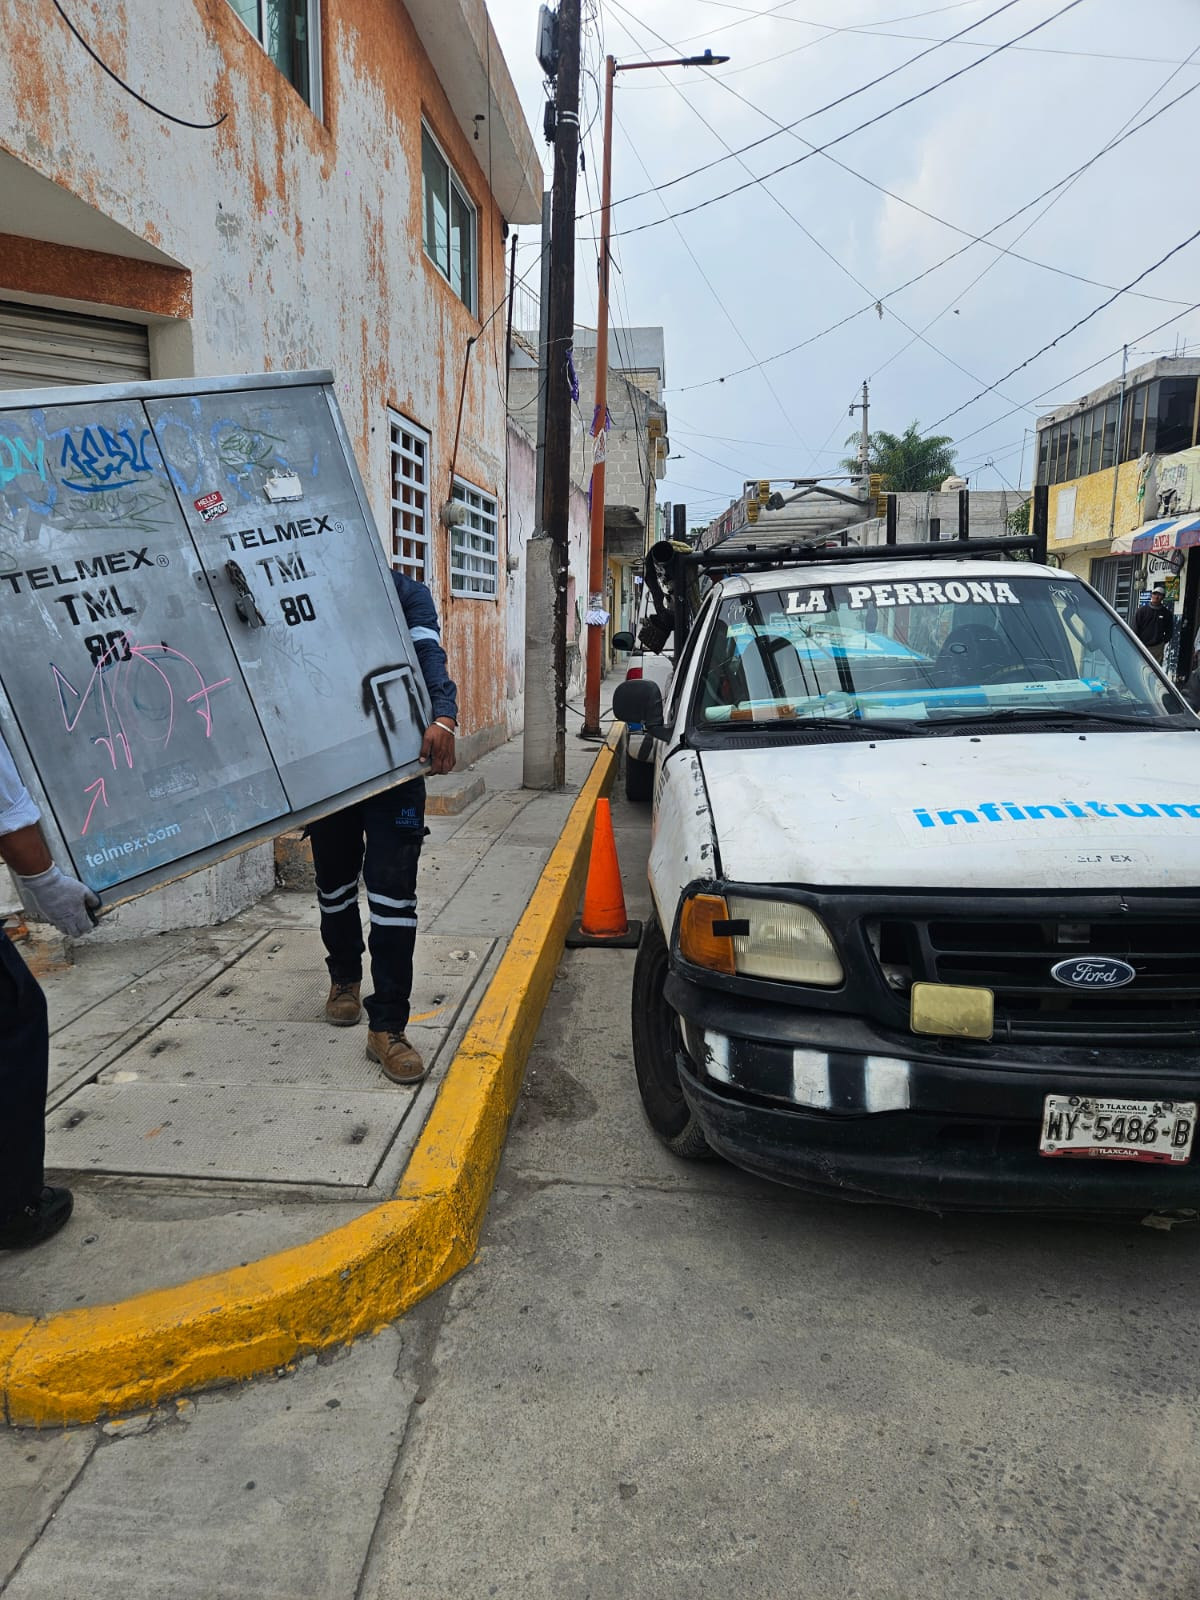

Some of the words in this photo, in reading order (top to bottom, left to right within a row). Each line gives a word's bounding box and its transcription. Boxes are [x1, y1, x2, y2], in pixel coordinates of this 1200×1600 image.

[255, 551, 317, 587] TML
[54, 584, 137, 626] TML
[280, 593, 317, 627] 80
[786, 590, 828, 614] LA
[848, 581, 1021, 609] PERRONA
[84, 630, 133, 668] 80
[912, 800, 1200, 828] infinitum
[85, 823, 182, 868] telmex.com
[1071, 962, 1118, 982] Ford
[1106, 1103, 1148, 1112] TLAXCALA
